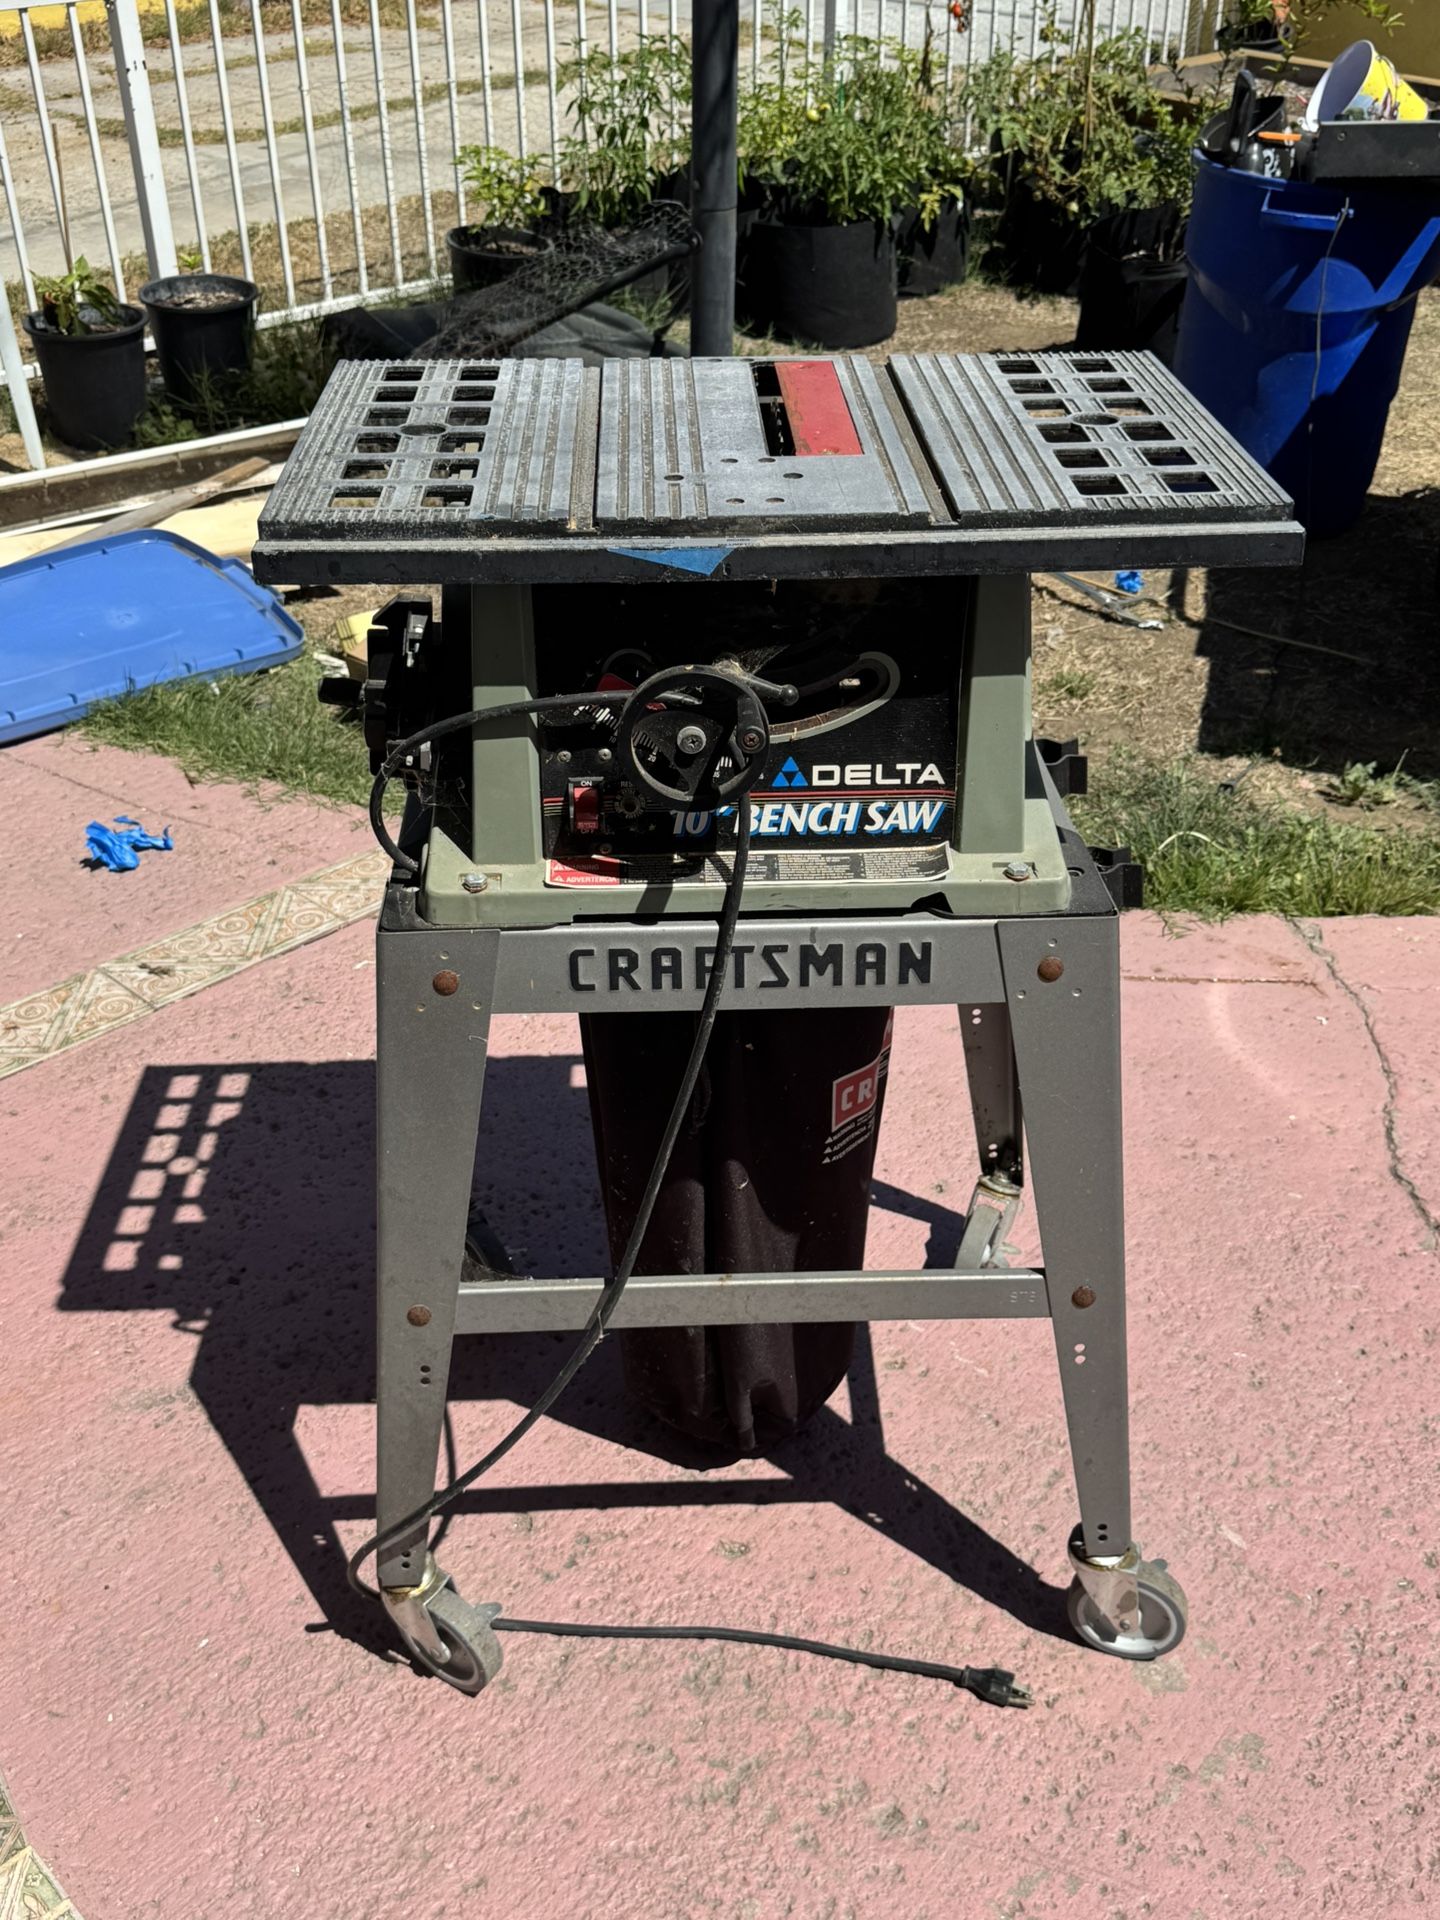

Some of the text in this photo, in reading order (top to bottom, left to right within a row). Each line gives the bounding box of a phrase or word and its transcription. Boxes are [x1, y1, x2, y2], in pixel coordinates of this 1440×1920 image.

[580, 779, 593, 787] ON
[811, 762, 945, 787] DELTA
[733, 801, 863, 837] BENCH
[863, 800, 947, 834] SAW
[566, 875, 618, 884] ADVERTENCIA
[568, 941, 932, 992] CRAFTSMAN
